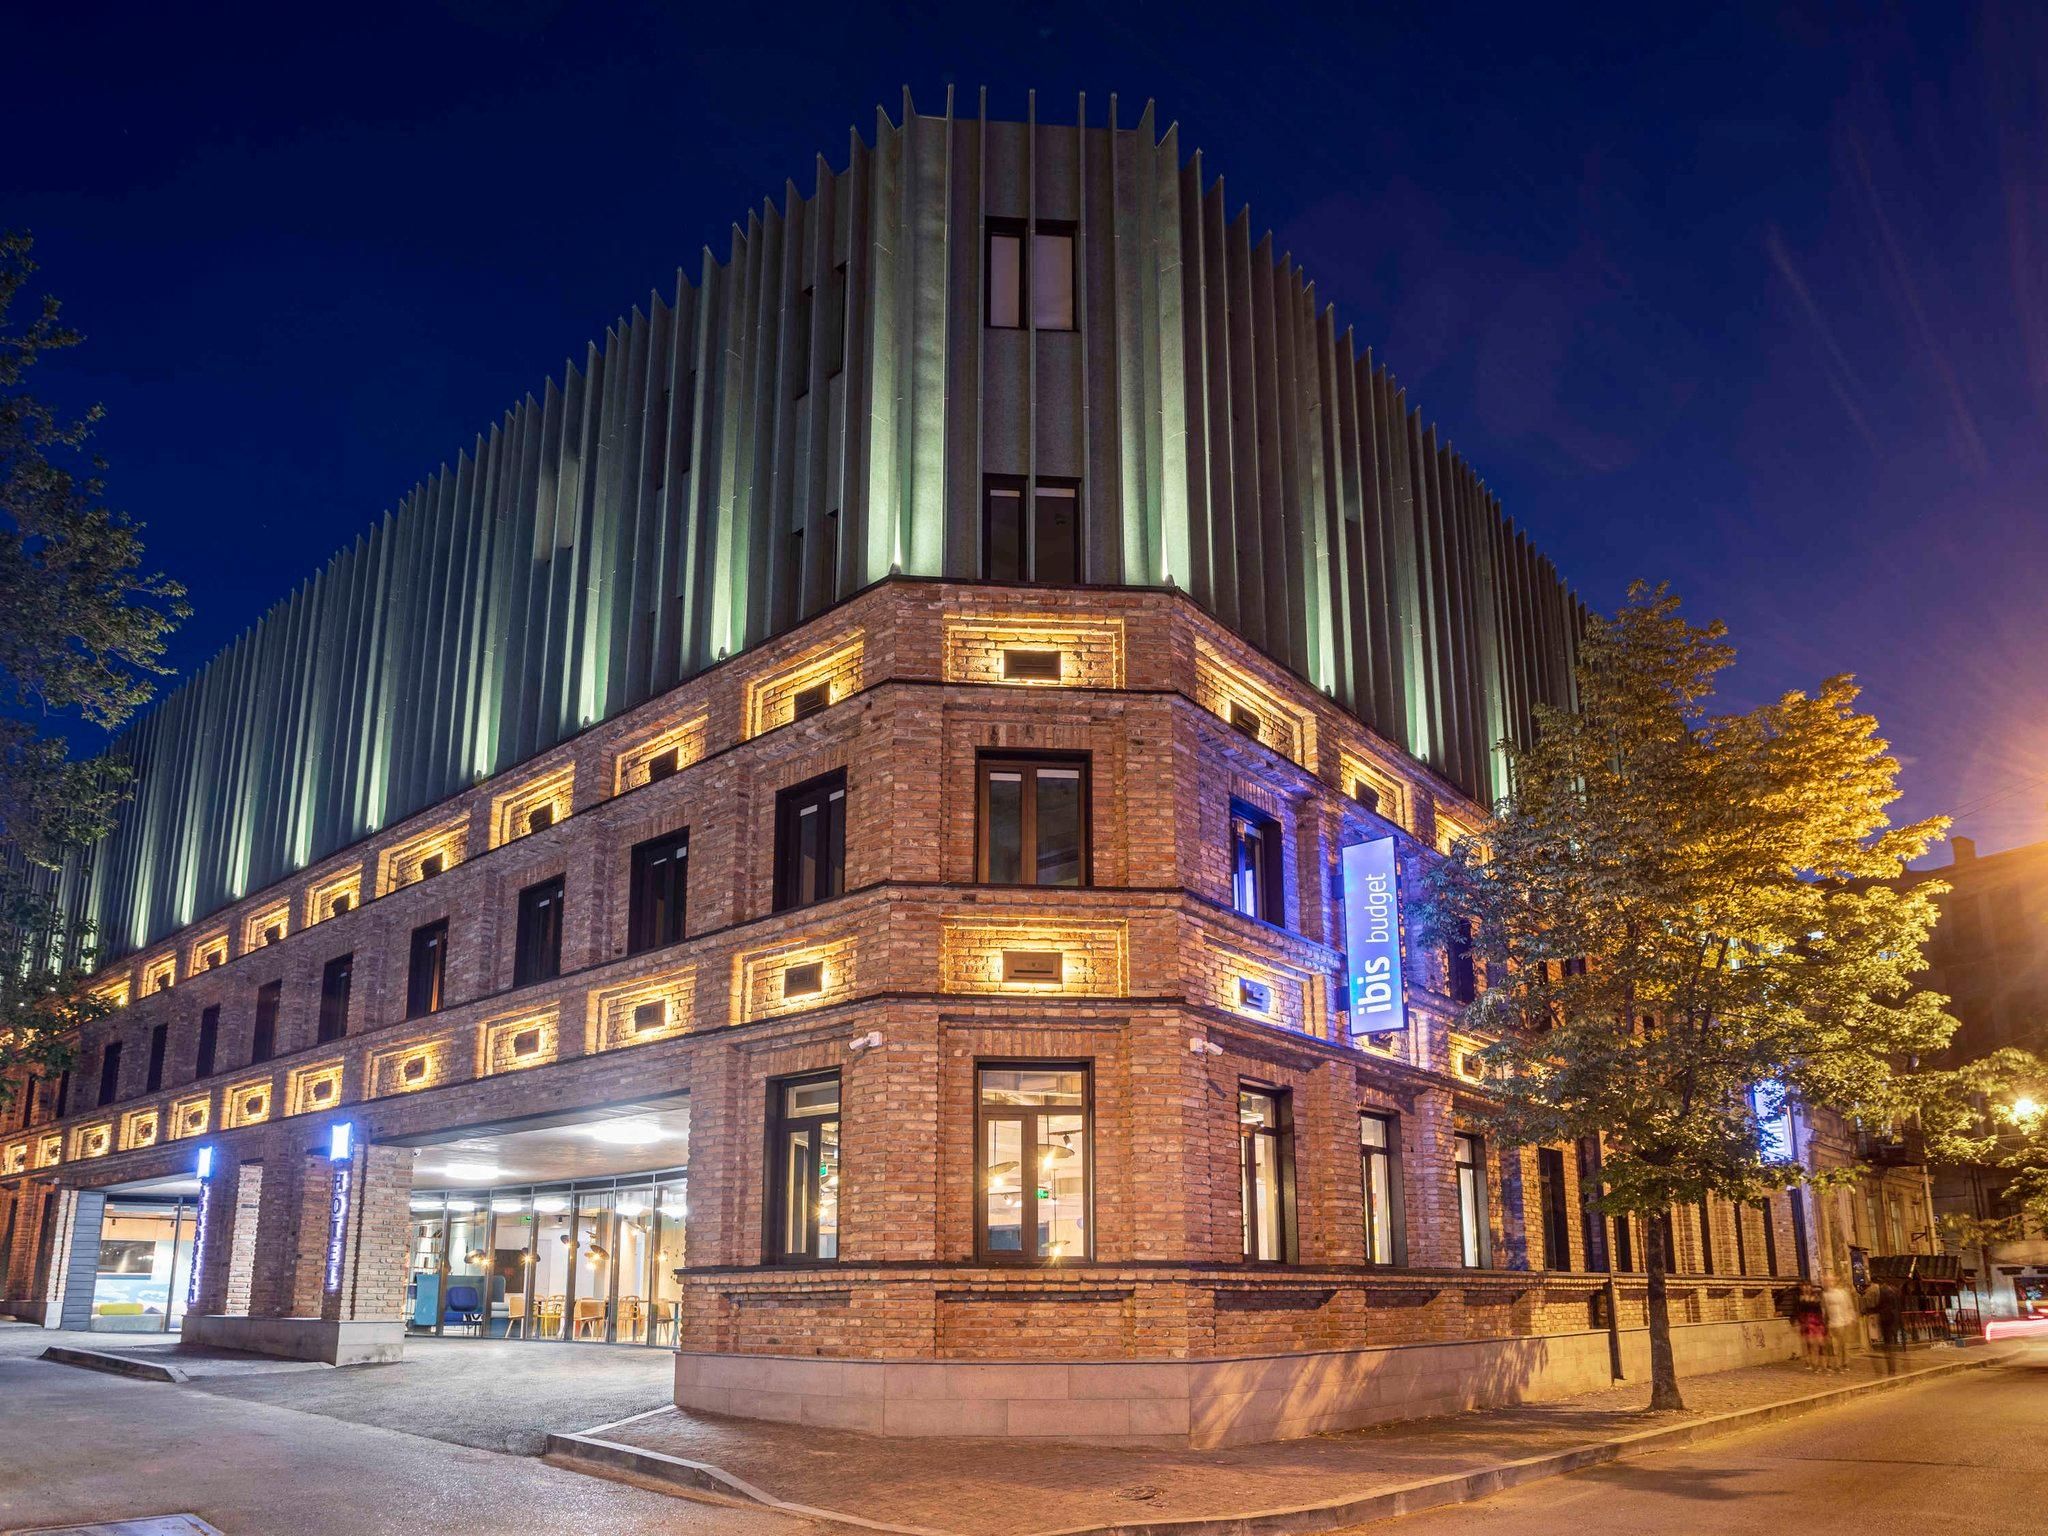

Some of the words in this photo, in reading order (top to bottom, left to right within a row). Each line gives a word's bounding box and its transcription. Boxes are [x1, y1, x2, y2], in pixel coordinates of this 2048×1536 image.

[1364, 872, 1393, 943] budget
[1356, 956, 1392, 1015] ibis
[326, 1171, 347, 1288] HOTEL
